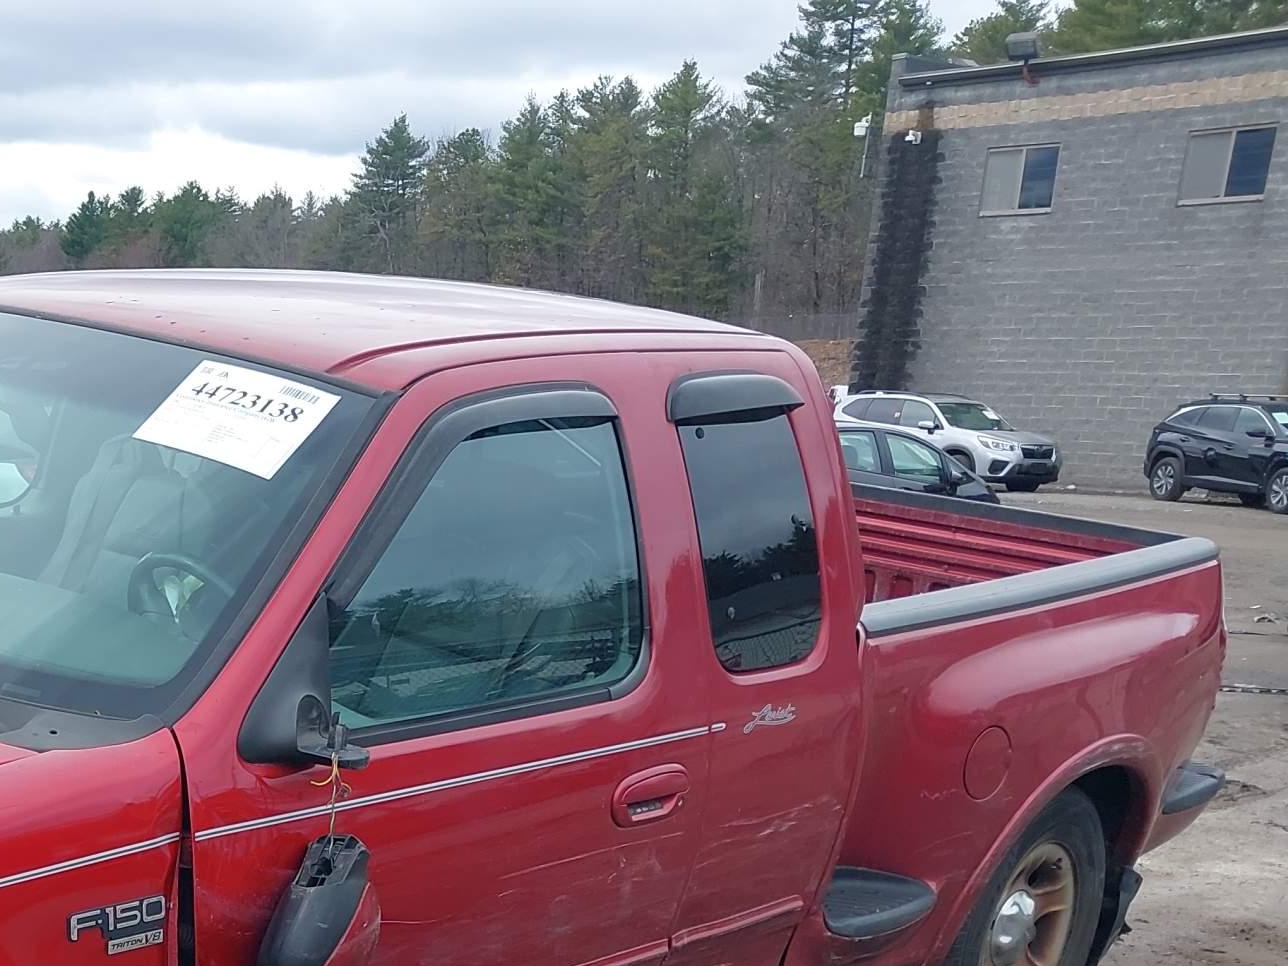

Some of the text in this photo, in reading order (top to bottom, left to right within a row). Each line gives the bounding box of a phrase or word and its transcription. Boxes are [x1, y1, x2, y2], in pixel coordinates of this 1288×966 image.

[191, 382, 304, 423] 44723138
[112, 931, 162, 951] TRITON V8
